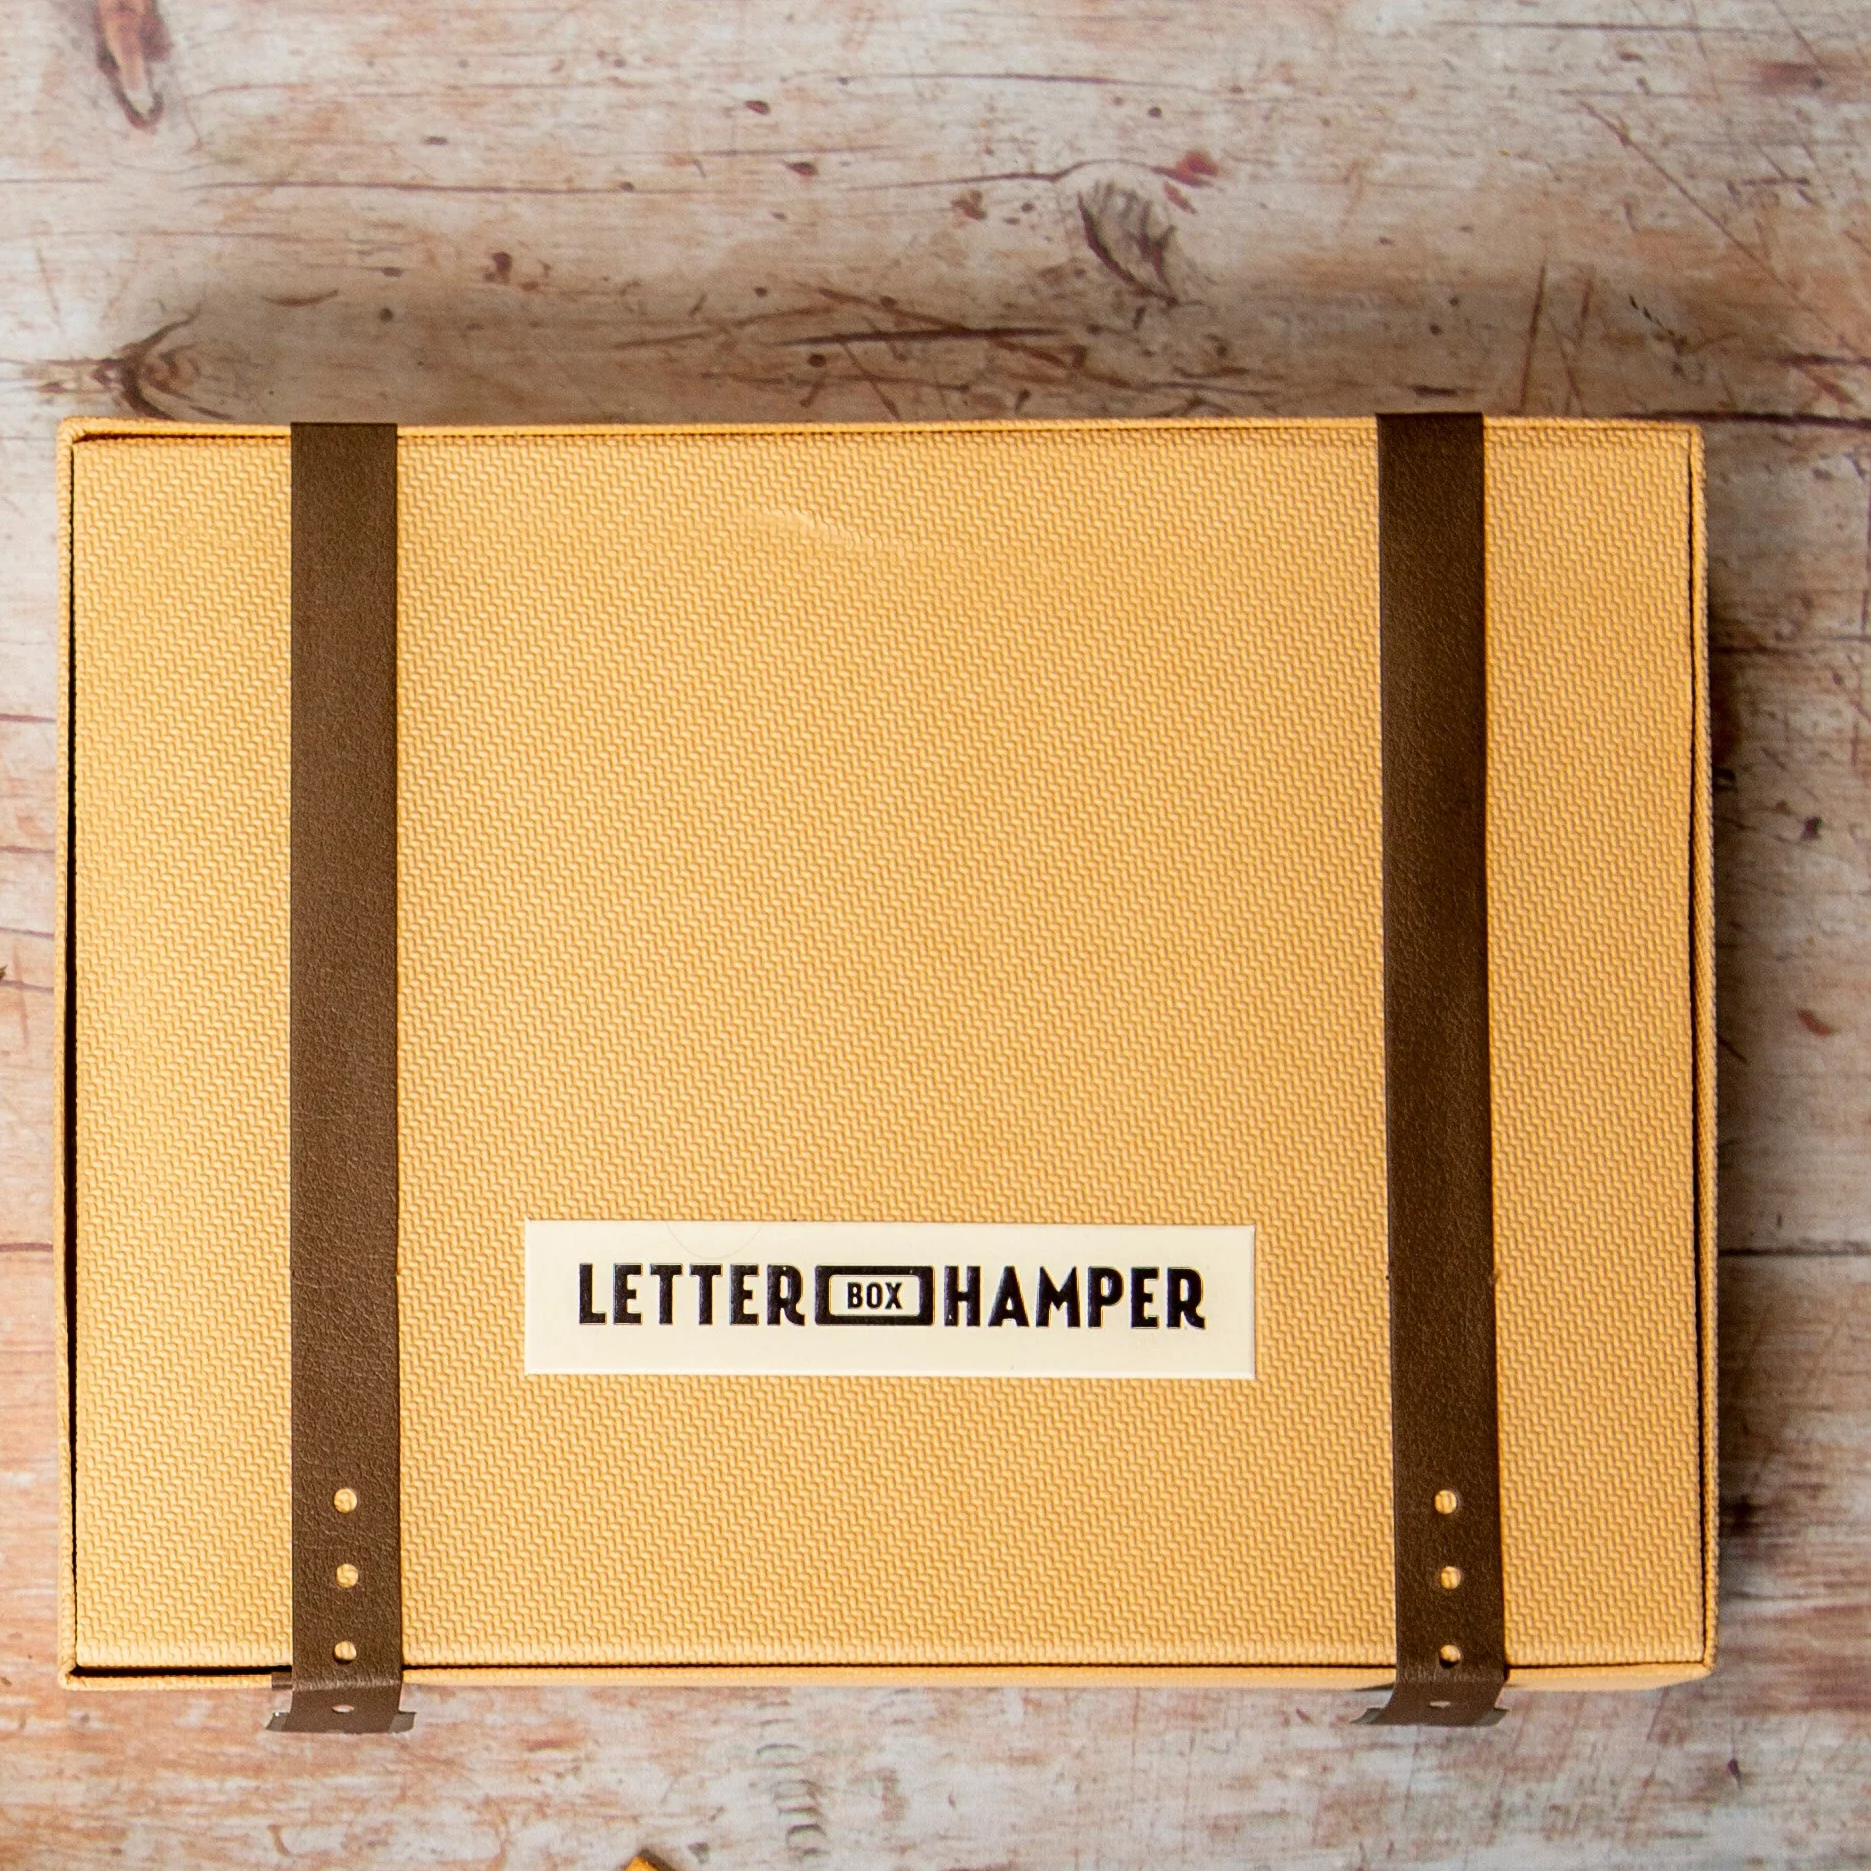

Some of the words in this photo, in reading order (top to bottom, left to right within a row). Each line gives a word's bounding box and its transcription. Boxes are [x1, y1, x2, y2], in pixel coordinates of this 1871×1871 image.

[578, 1263, 806, 1326] LETTER
[846, 1281, 903, 1311] BOX
[945, 1265, 1207, 1330] HAMPER
